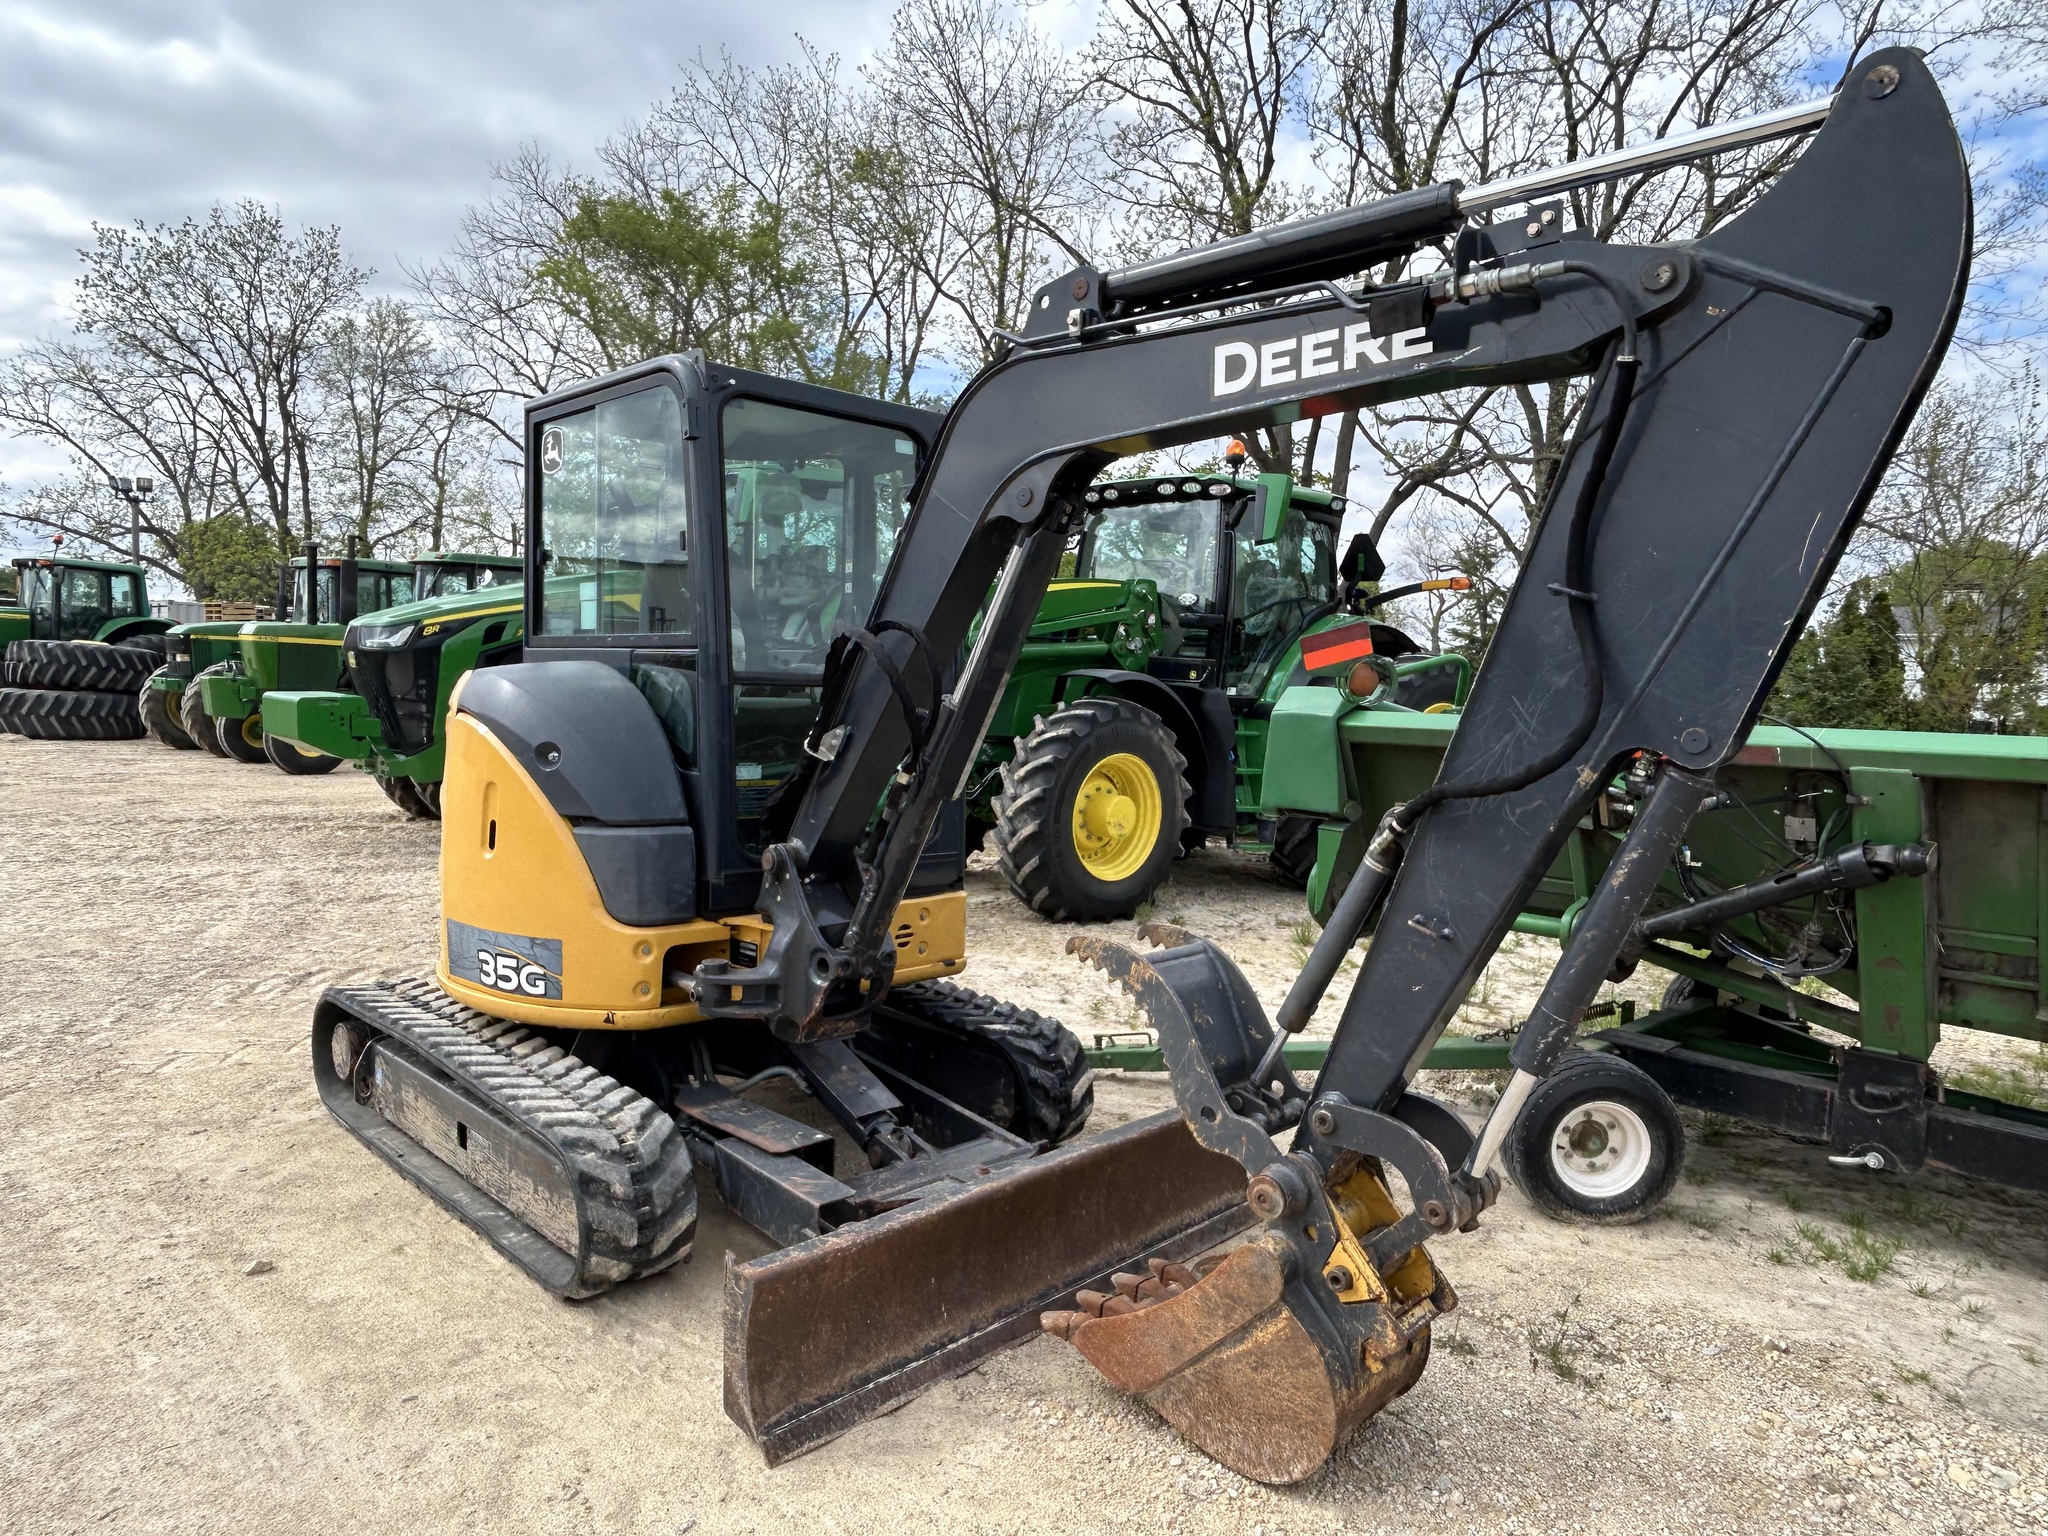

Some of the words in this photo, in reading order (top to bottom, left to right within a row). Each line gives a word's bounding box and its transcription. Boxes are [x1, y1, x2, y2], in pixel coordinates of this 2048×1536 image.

[1213, 320, 1434, 397] DEERE
[423, 624, 441, 636] 8R
[477, 949, 547, 996] 35G
